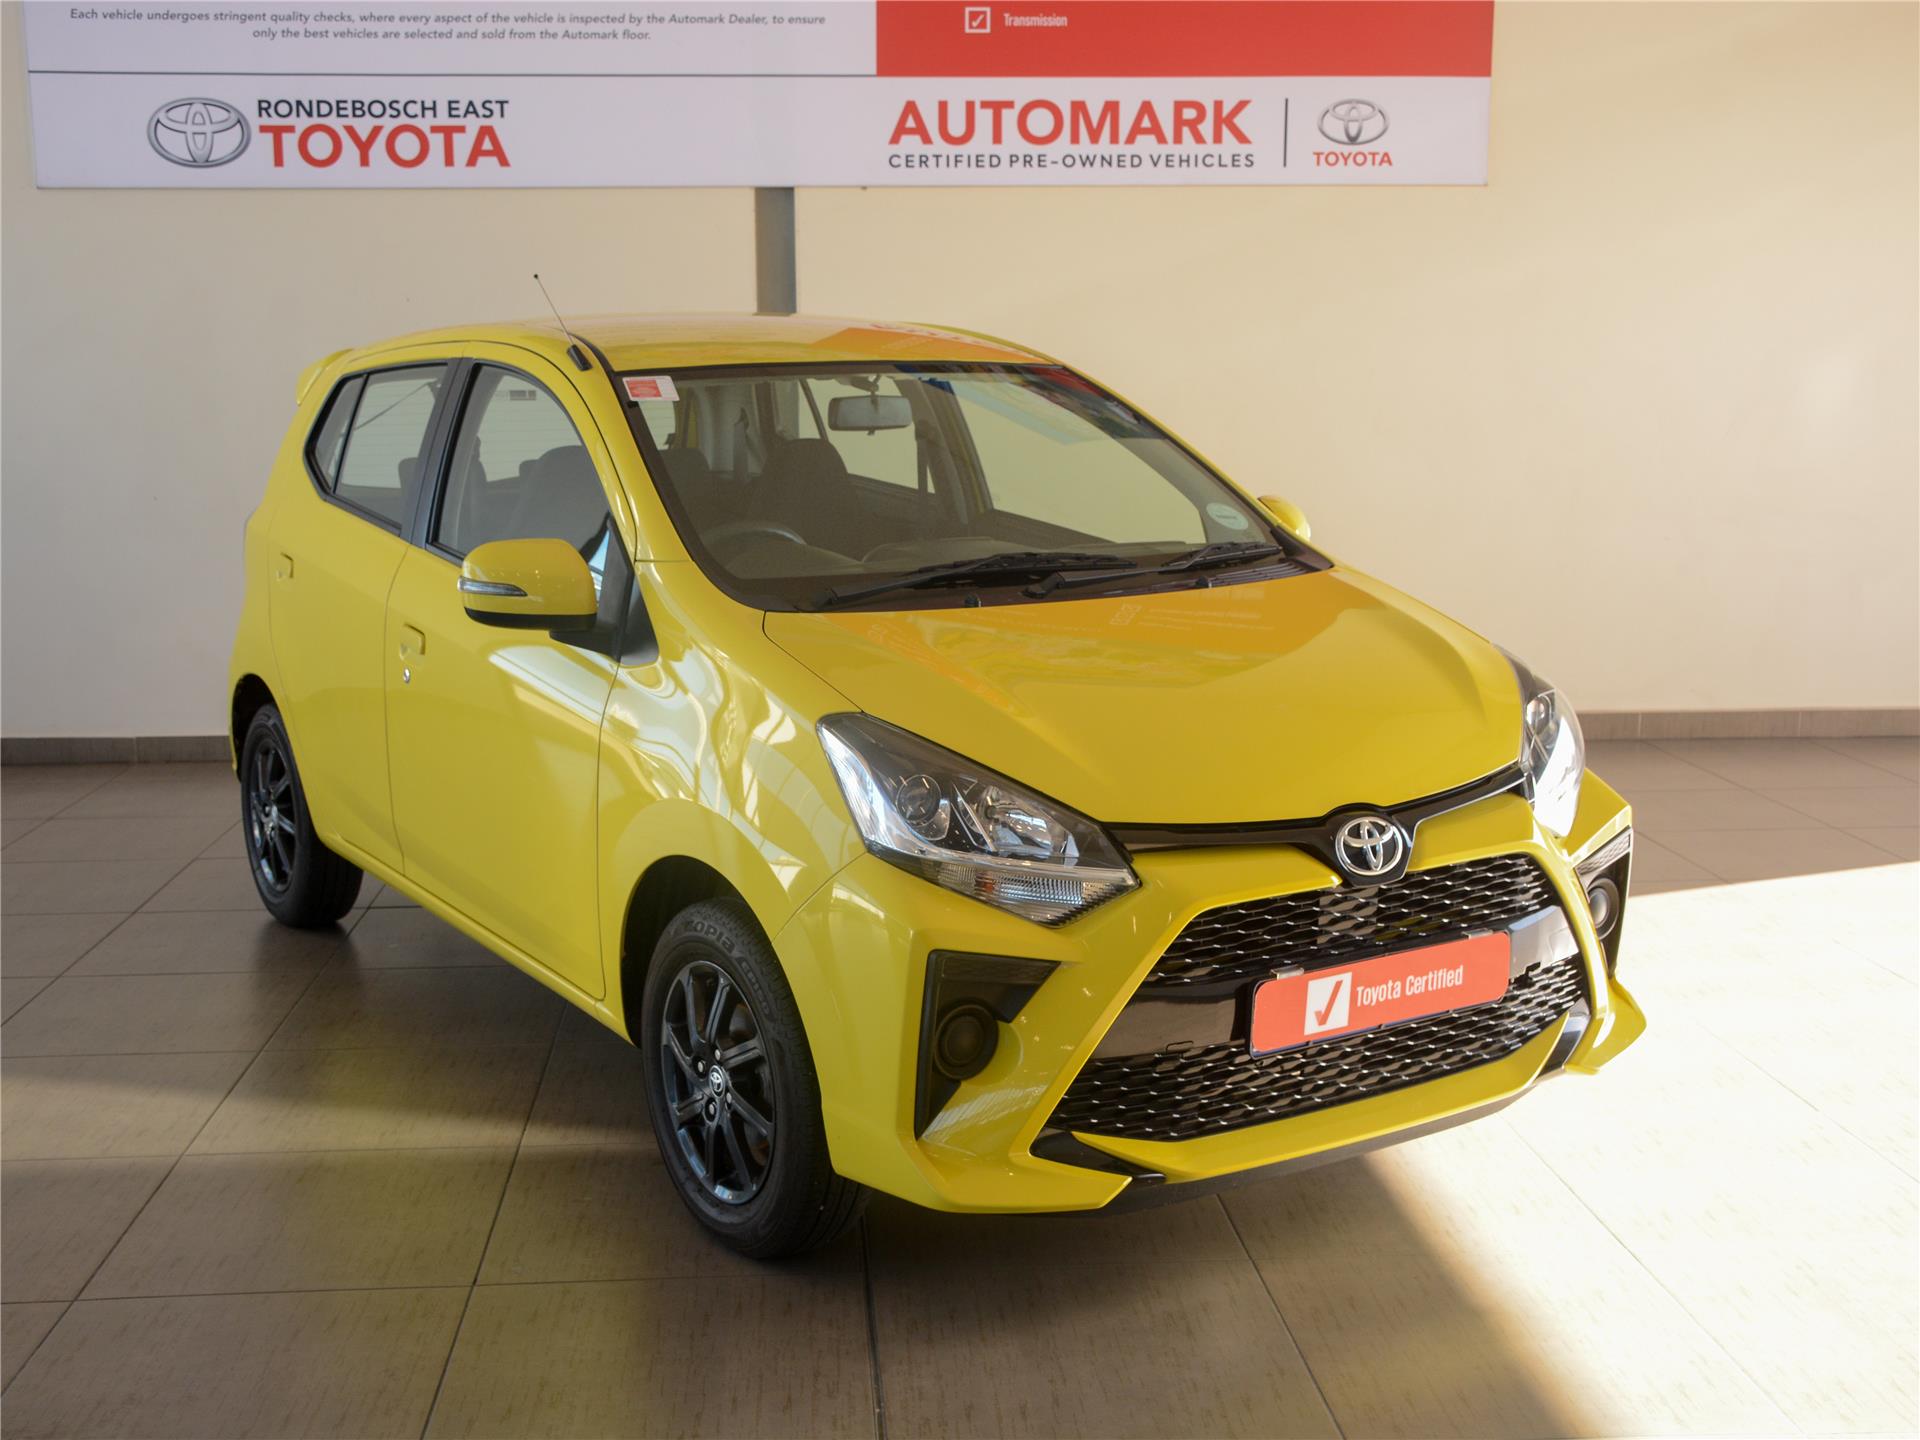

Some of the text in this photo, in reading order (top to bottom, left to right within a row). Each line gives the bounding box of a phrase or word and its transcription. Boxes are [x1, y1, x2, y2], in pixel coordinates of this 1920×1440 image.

[70, 8, 826, 25] Each vehicle undergoes stringent quality checks, where every aspect of the vehicle is inspected by the Automark Dealer, to ensure
[1003, 12, 1068, 27] Transmission
[252, 27, 652, 40] only the best vehicles are selected and sold from the Automark floor.
[257, 99, 510, 119] RONDEBOSCH EAST
[887, 99, 1253, 146] AUTOMARK
[258, 123, 512, 169] TOYOTA
[888, 153, 1255, 169] CERTIFIED PRE-OWNED VEHICLES
[1312, 150, 1393, 168] TOYOTA
[1356, 964, 1464, 1008] Toyota Certified
